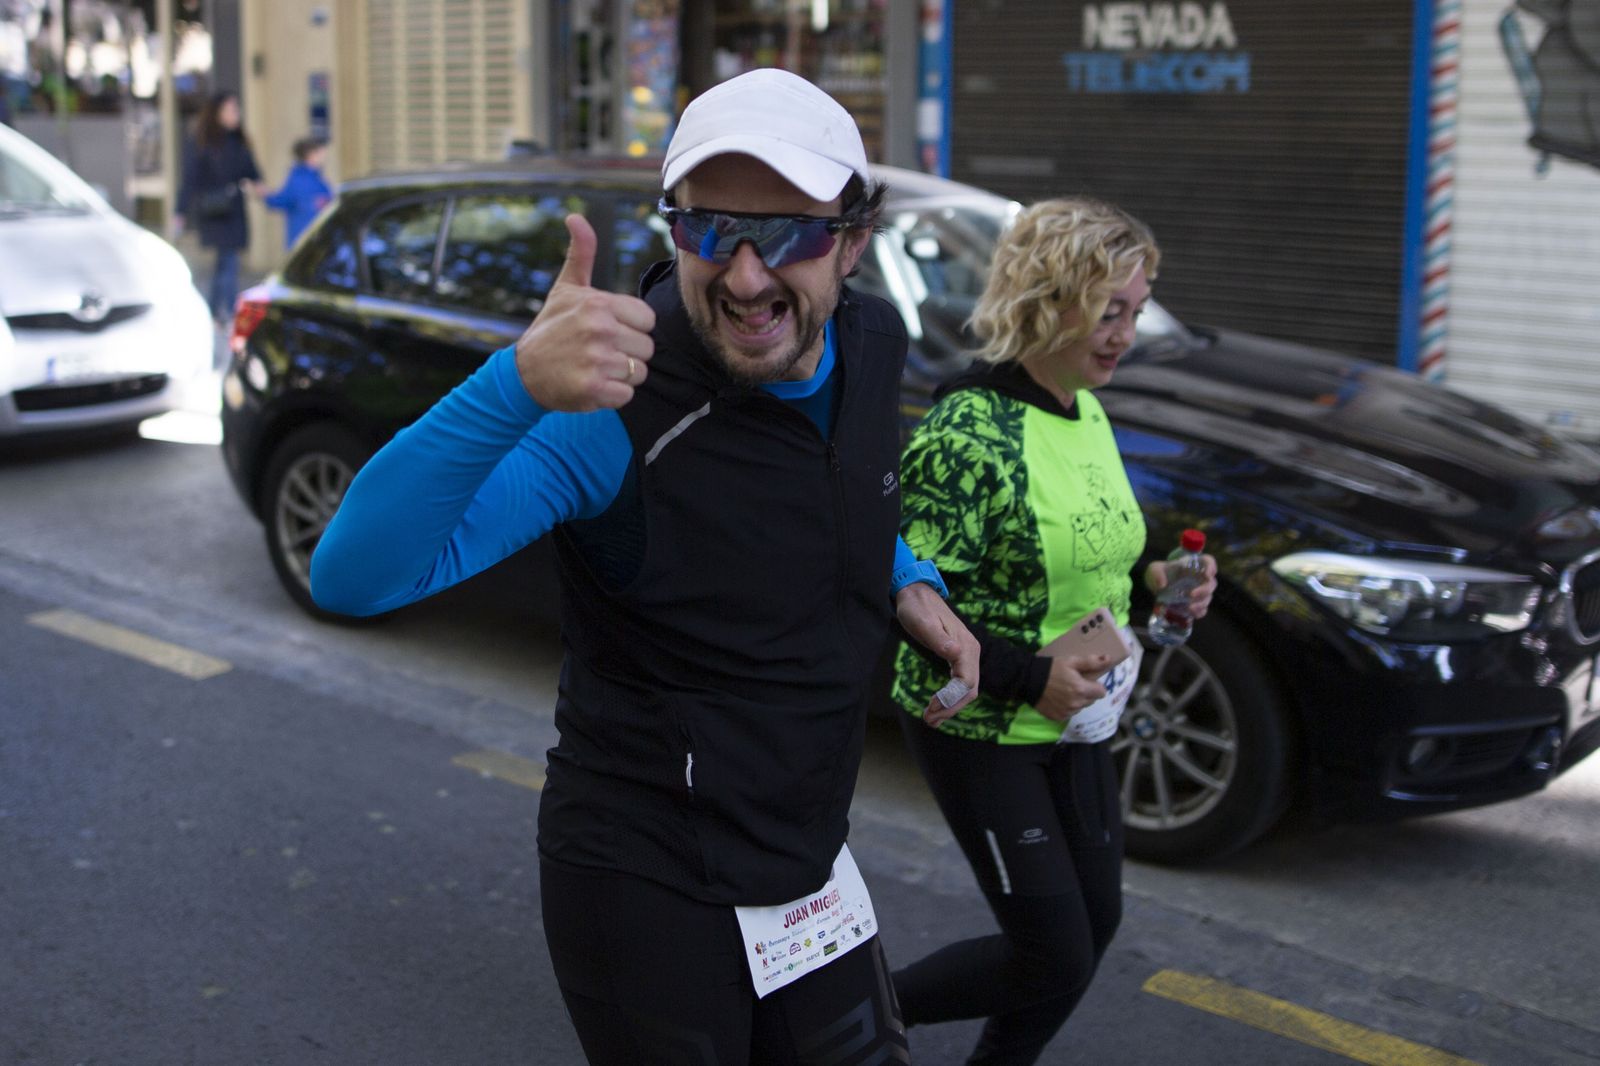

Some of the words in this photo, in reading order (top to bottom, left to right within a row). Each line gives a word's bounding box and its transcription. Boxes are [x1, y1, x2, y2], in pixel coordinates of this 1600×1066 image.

[1083, 2, 1237, 48] NEVADA
[783, 905, 810, 929] JUAN
[810, 888, 841, 916] MIGUEL
